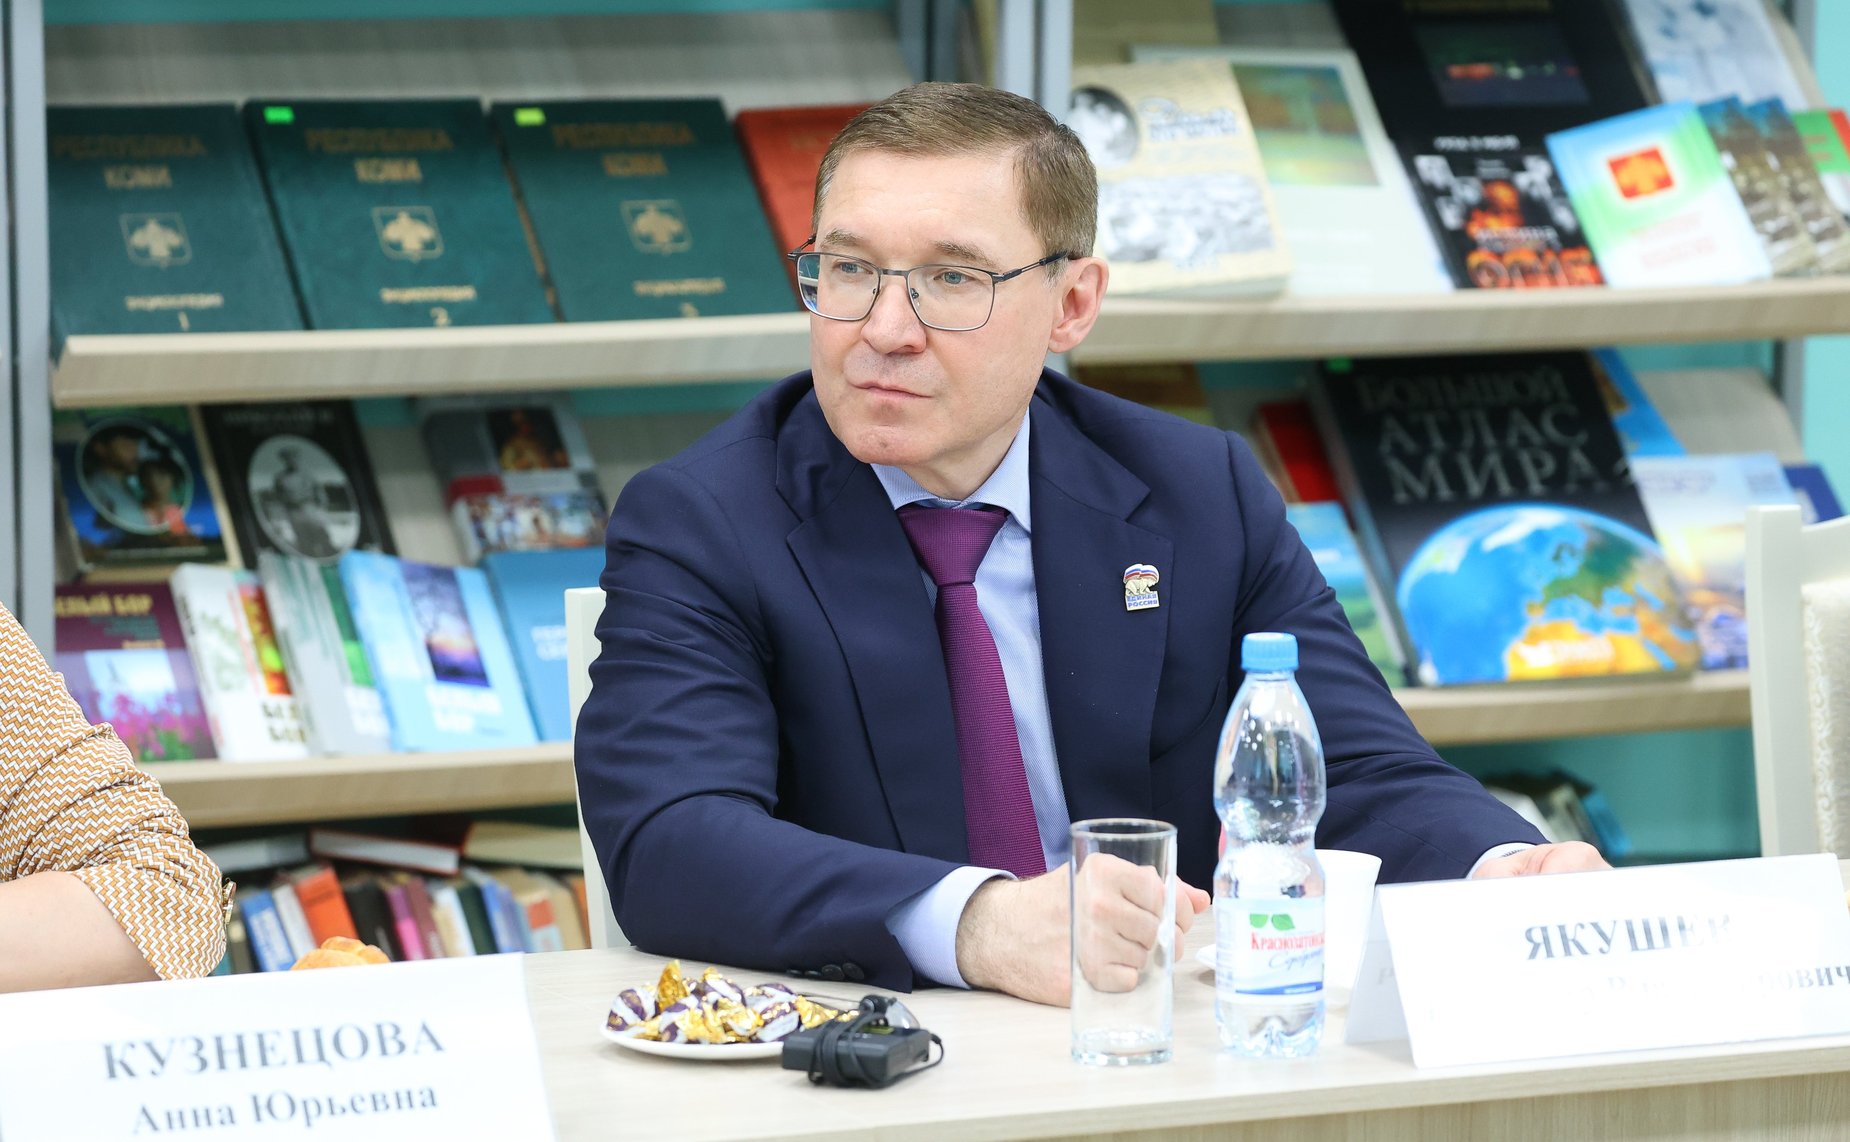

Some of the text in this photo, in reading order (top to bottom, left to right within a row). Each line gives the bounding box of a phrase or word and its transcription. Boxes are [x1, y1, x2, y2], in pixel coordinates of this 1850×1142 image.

[177, 311, 191, 332] 1
[429, 306, 452, 327] 2
[1355, 365, 1573, 412] БОЛЬШОЙ
[1378, 404, 1590, 455] АТЛАС
[1381, 447, 1611, 504] МИРА
[55, 592, 112, 617] ЕЛЫЙ
[1127, 600, 1158, 608] РОССИЯ
[102, 1020, 445, 1081] КУЗНЕЦОВА
[132, 1085, 439, 1136] Анна Юрьевна
